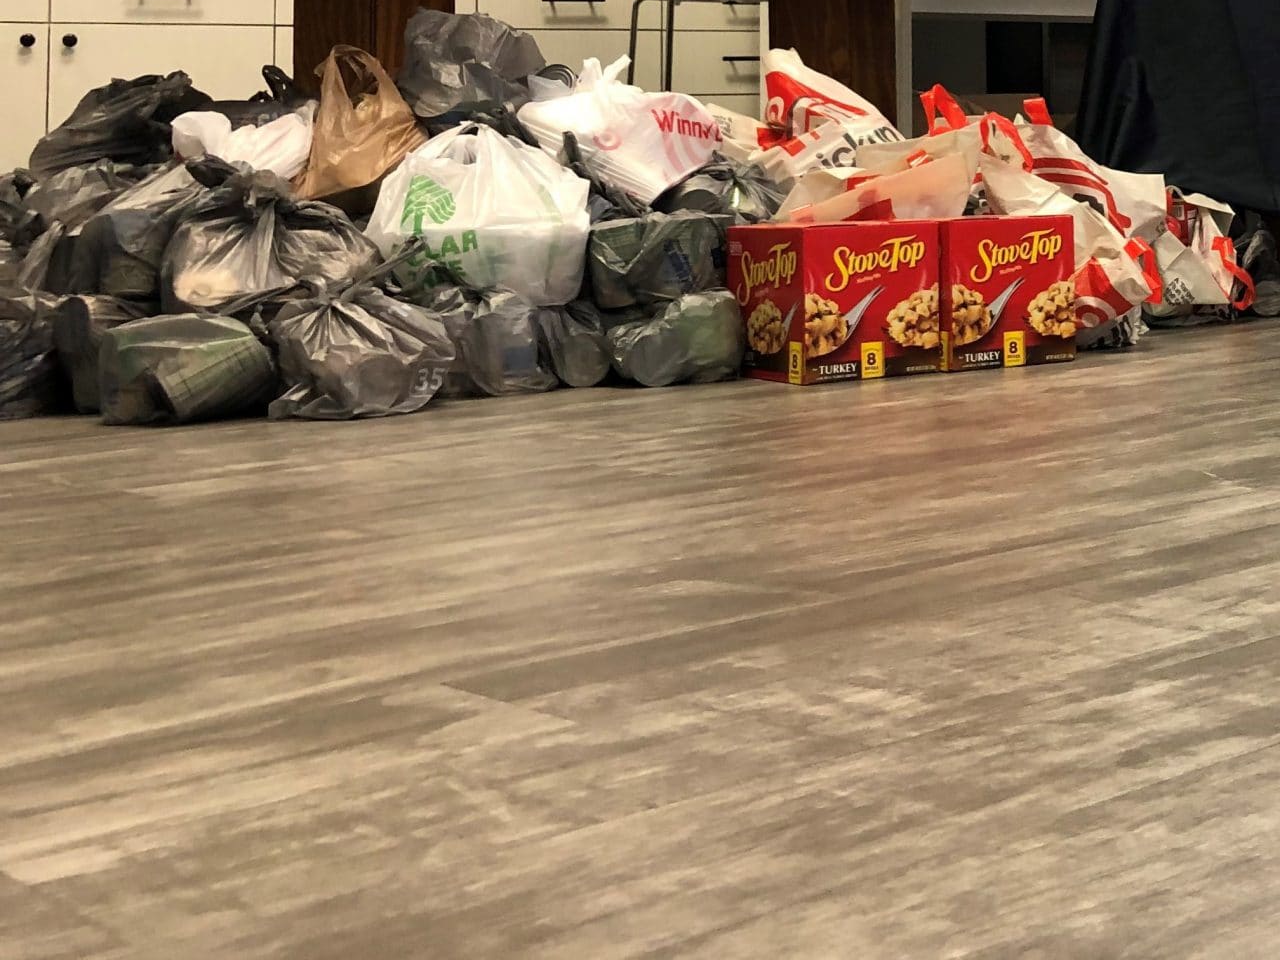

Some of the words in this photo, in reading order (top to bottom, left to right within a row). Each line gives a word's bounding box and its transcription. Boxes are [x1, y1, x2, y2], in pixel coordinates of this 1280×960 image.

[1008, 341, 1018, 354] 8
[866, 351, 877, 366] 8
[964, 350, 1001, 363] TURKEY
[818, 362, 858, 376] TURKEY
